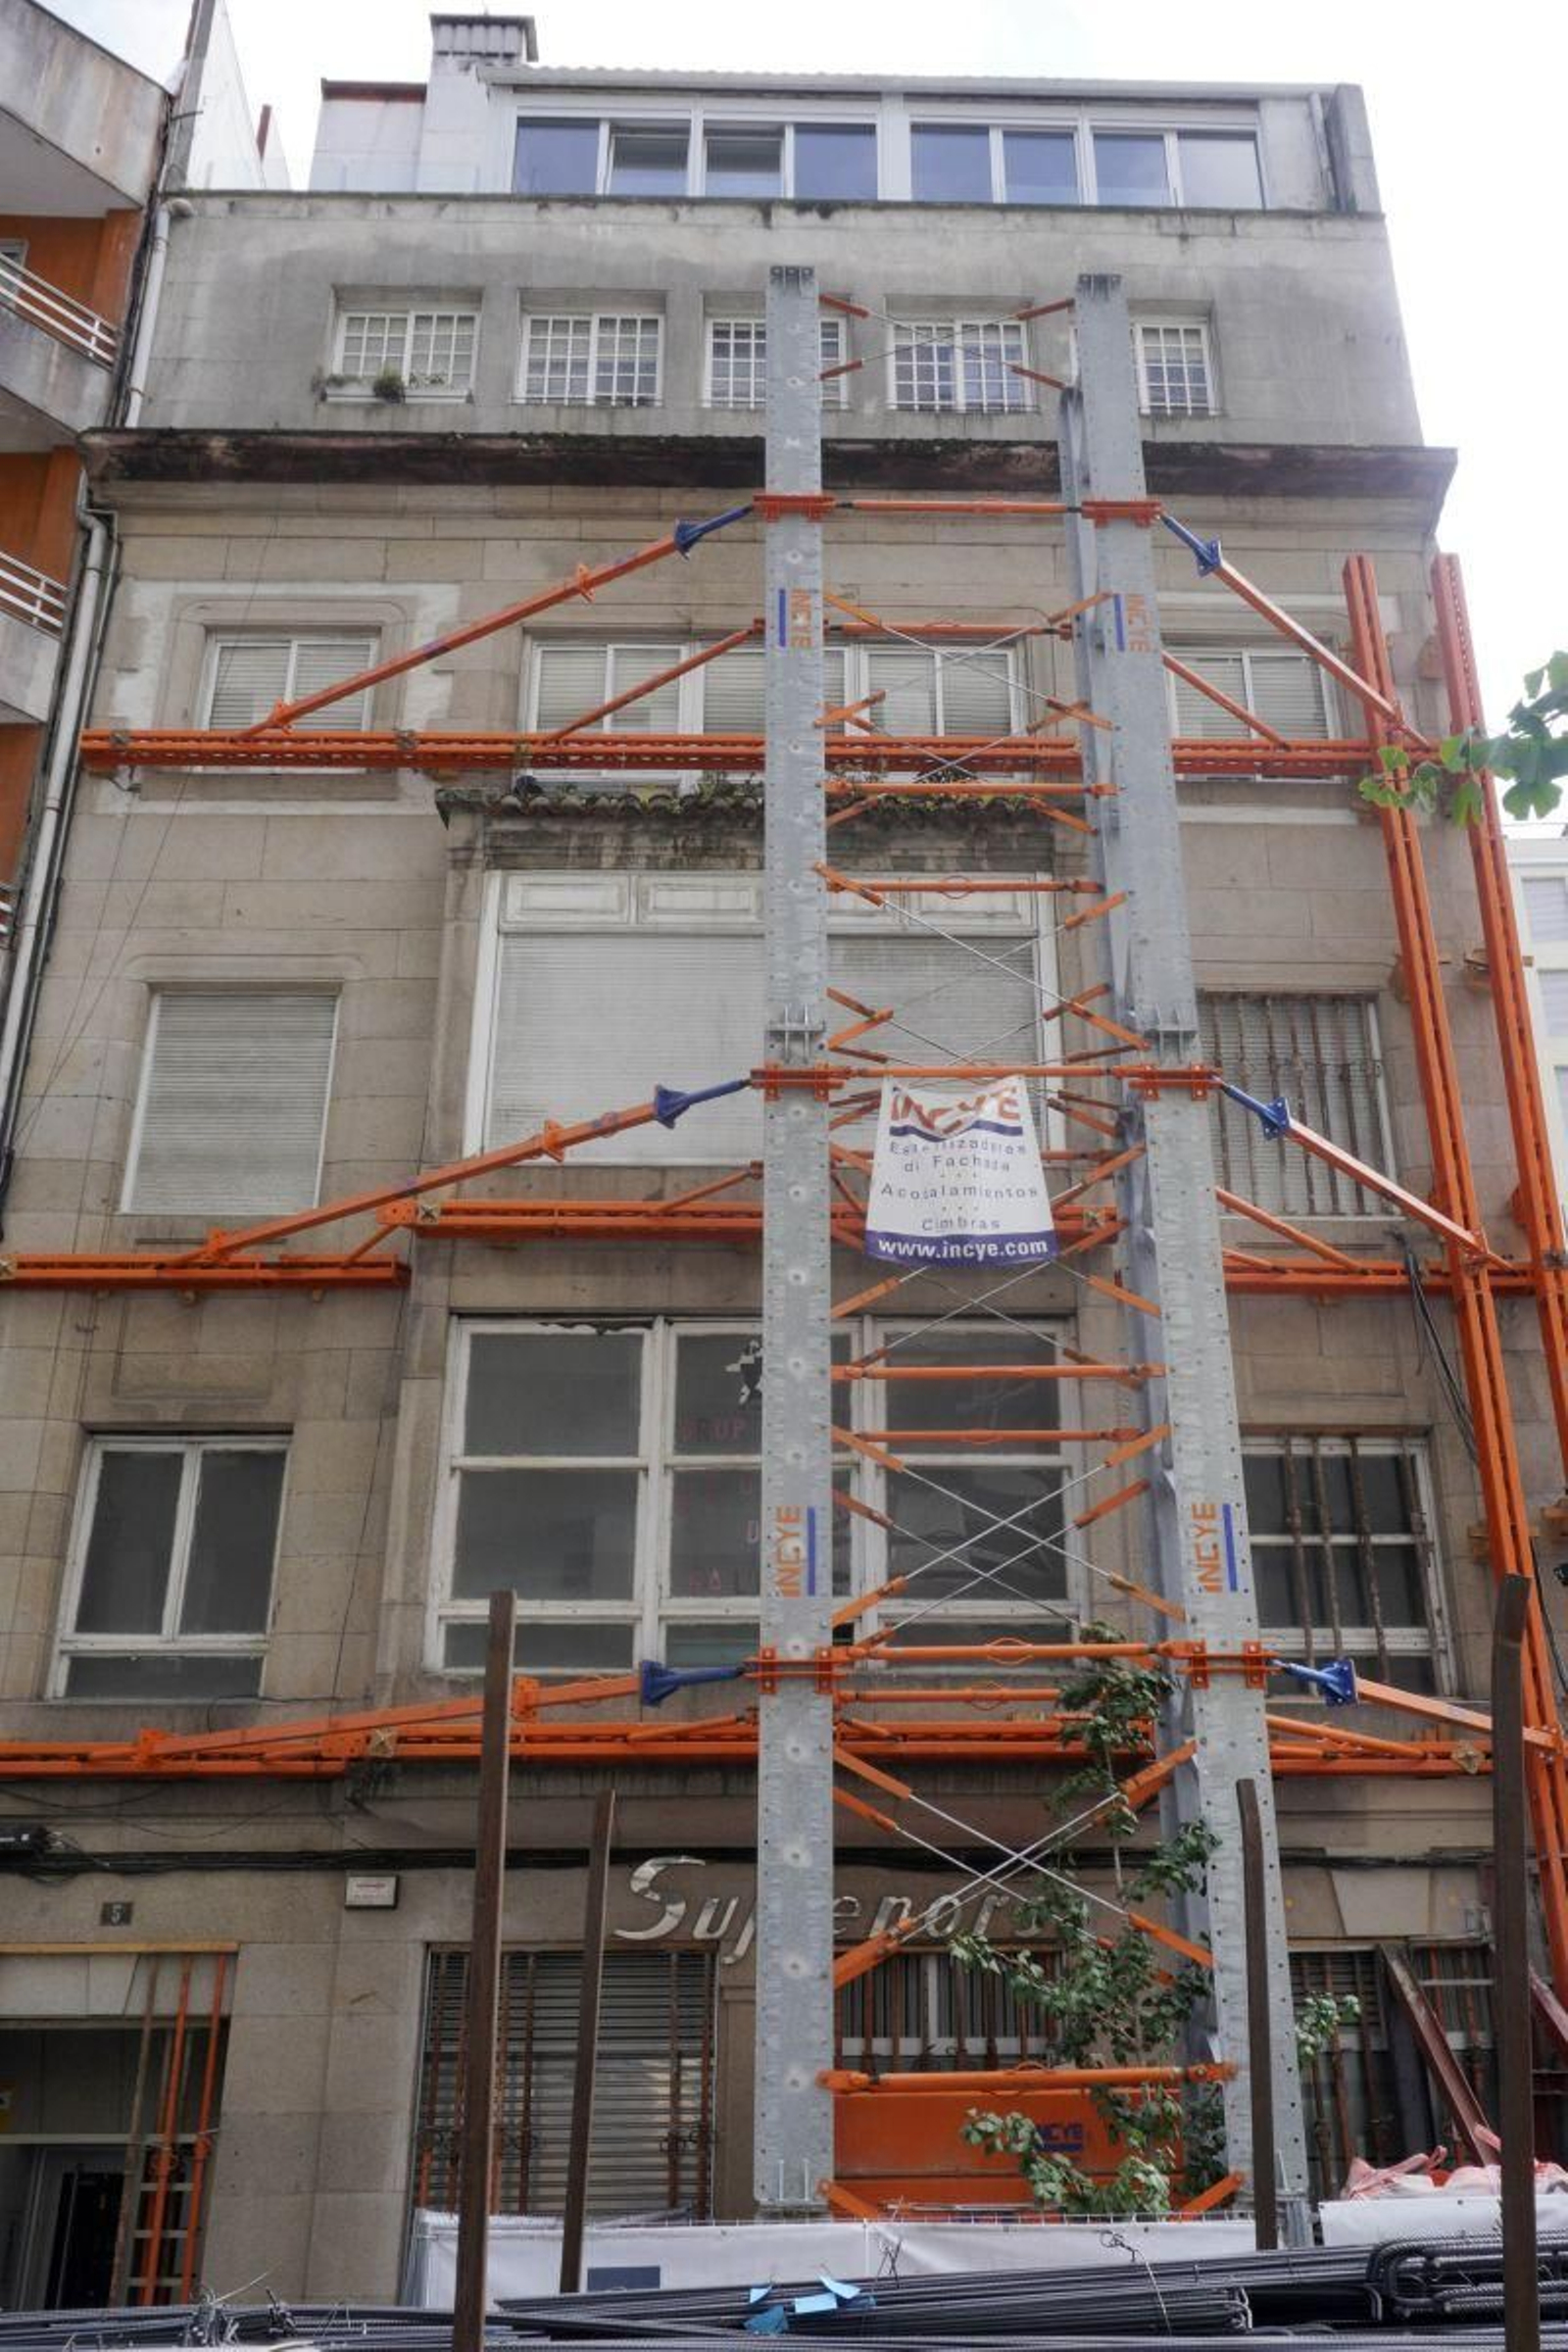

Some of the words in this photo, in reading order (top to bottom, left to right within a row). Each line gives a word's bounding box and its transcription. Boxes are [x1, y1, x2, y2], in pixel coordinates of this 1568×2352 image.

[878, 1239, 1049, 1262] www.incye.com
[776, 1502, 801, 1598] INCYE
[1192, 1502, 1223, 1593] INCYE
